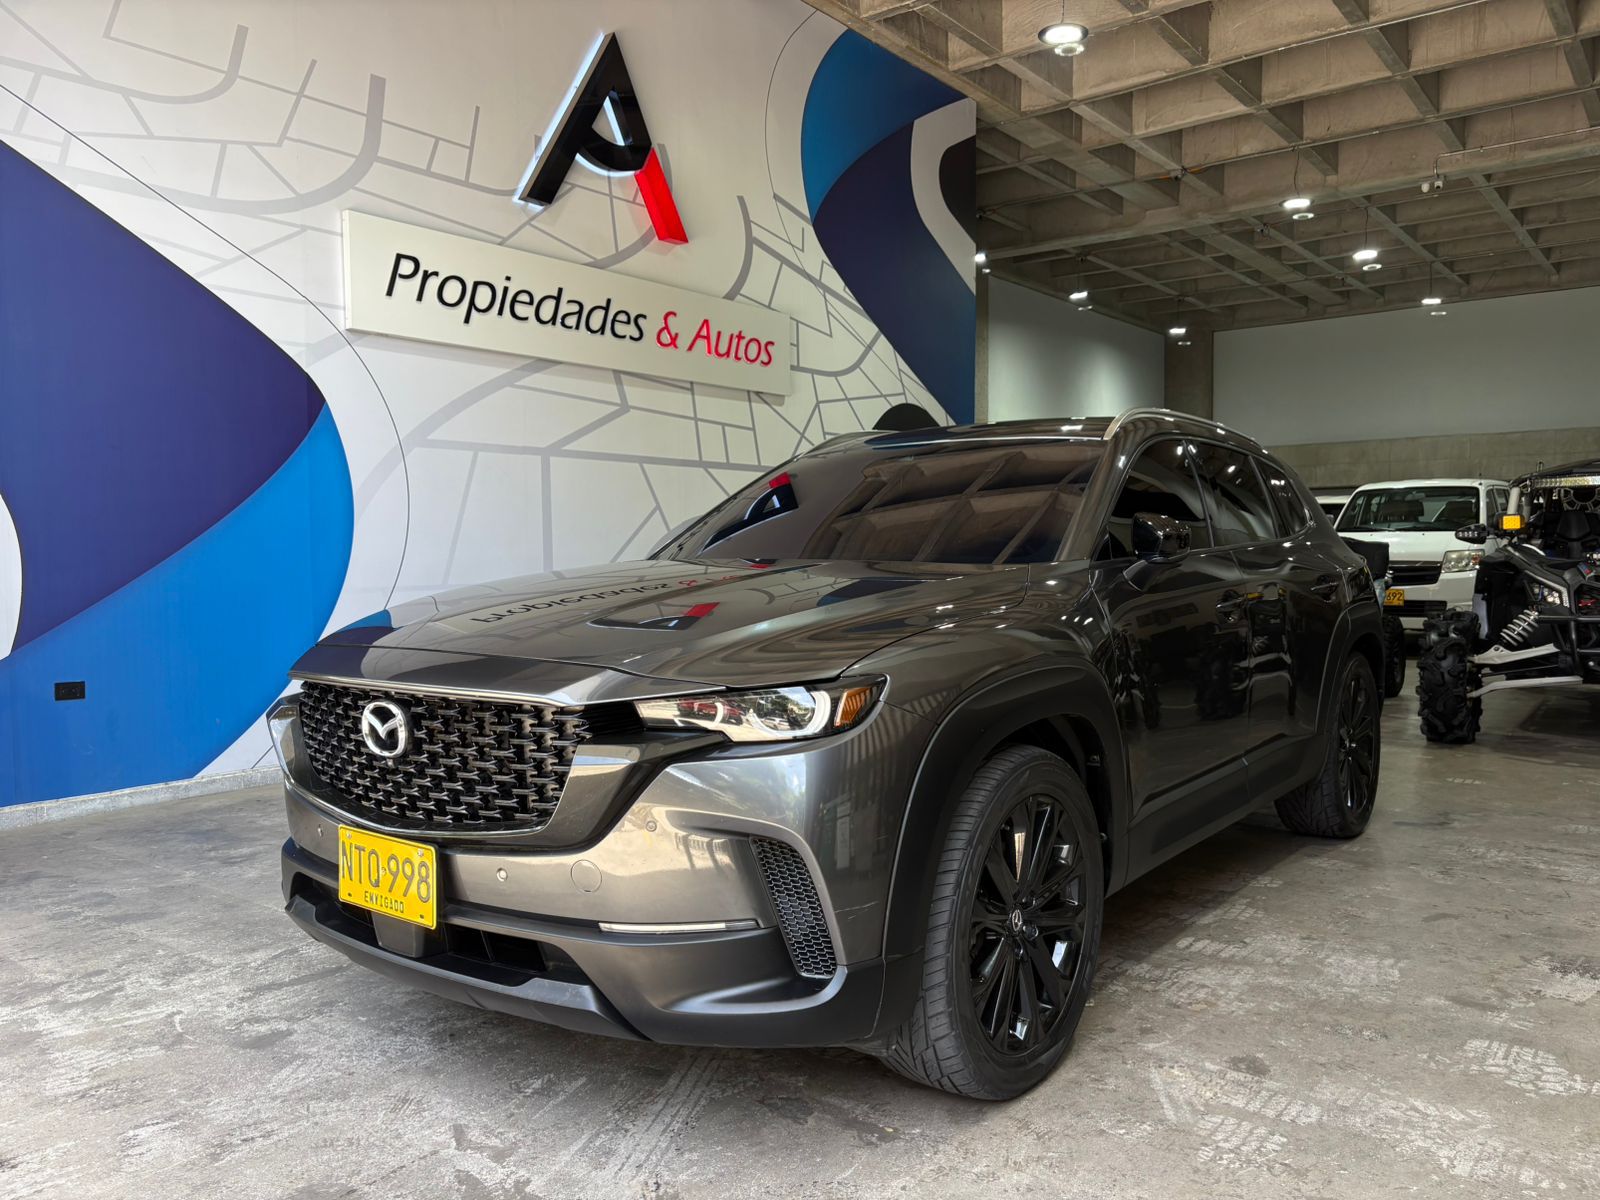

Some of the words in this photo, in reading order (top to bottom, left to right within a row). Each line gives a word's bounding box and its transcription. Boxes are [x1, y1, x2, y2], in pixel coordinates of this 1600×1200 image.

[385, 252, 647, 342] Propiedades
[656, 311, 679, 350] &
[686, 318, 775, 367] Autos
